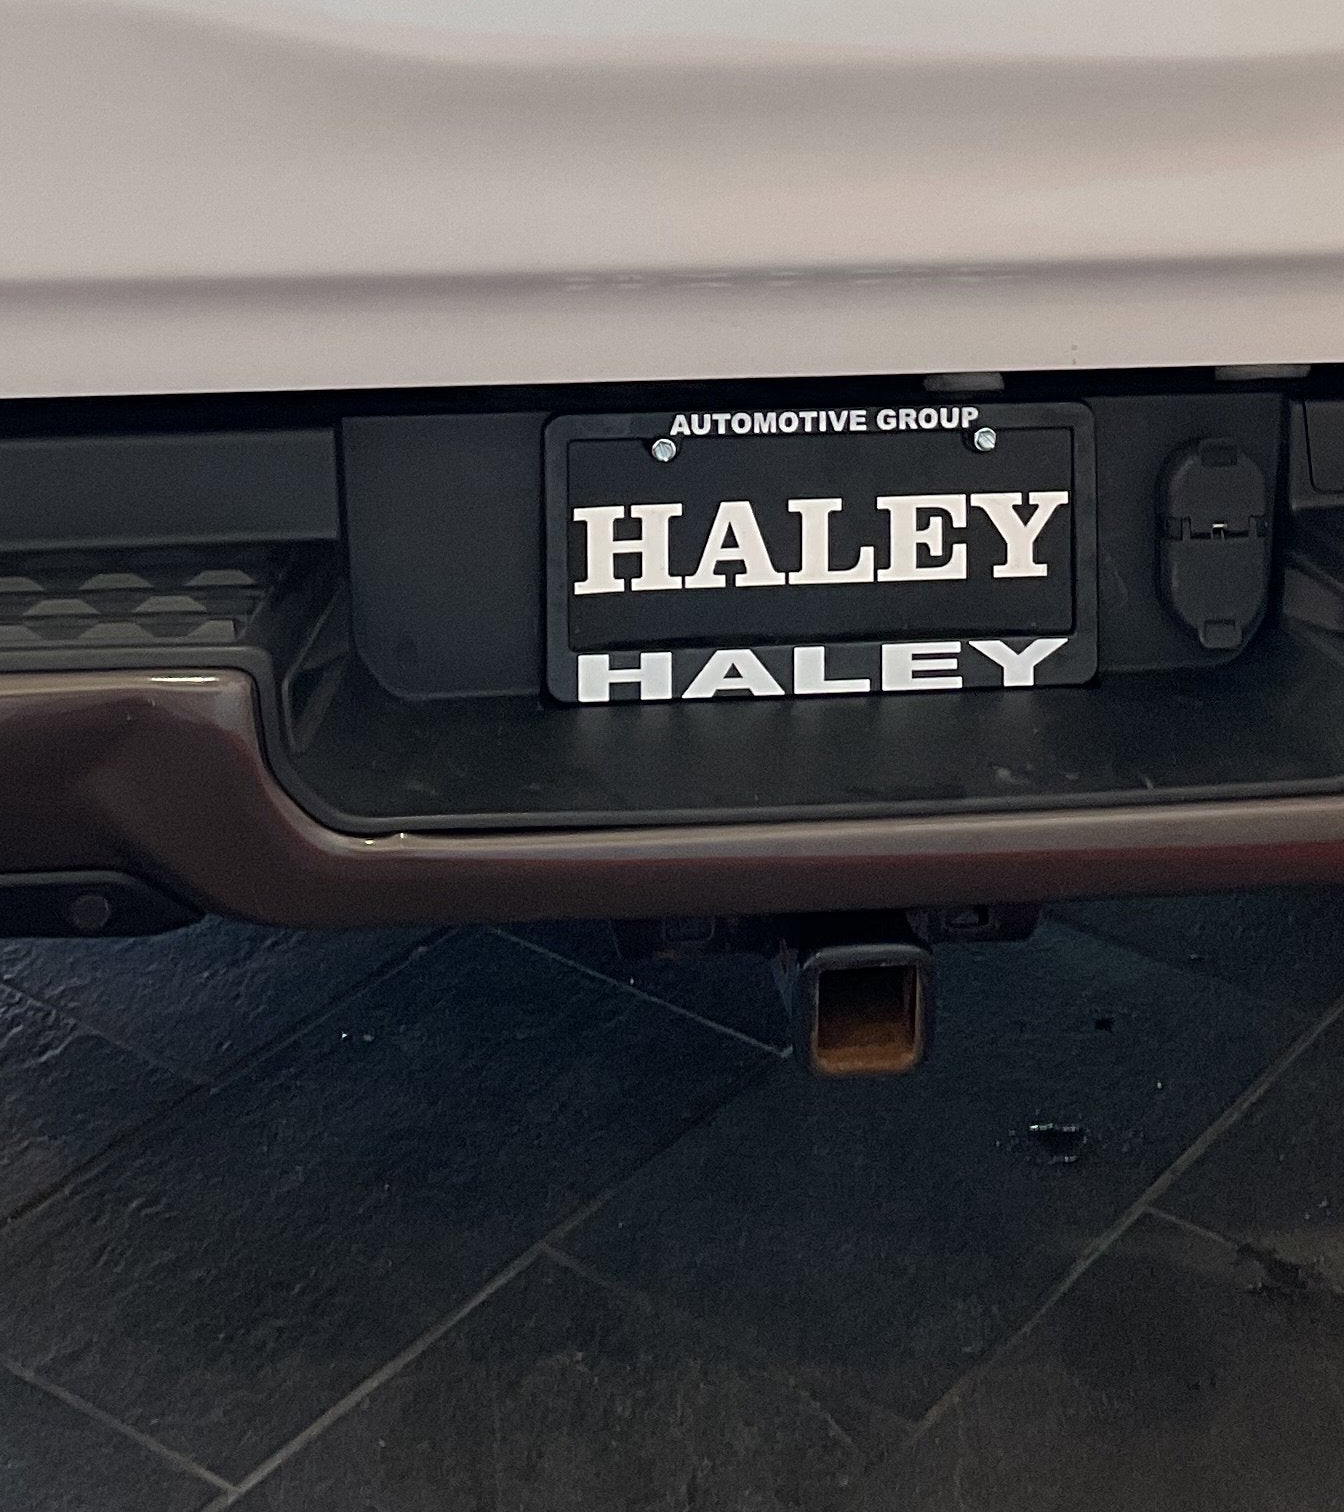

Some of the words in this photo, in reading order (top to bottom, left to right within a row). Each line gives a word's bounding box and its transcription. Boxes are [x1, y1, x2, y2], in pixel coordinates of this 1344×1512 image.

[669, 410, 868, 437] AUTOMOTIVE
[875, 406, 980, 431] GROUP
[572, 489, 1069, 596] HALEY
[575, 637, 1069, 704] HALEY
